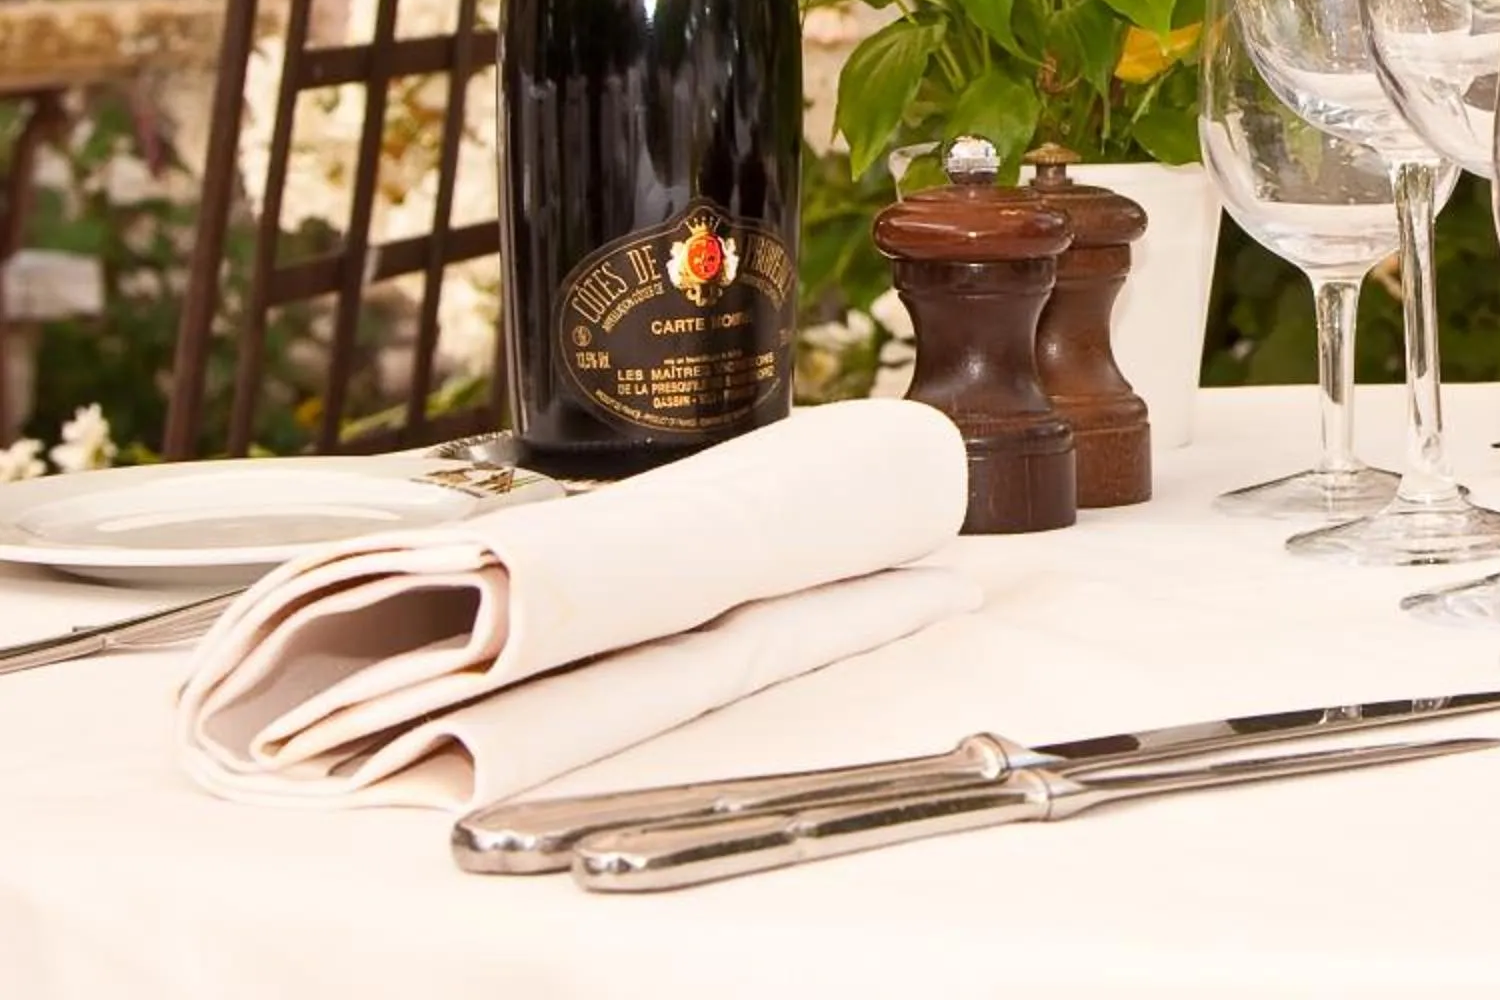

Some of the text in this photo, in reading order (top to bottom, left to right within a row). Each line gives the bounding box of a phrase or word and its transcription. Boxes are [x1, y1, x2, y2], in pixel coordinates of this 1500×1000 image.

[626, 245, 662, 284] DE
[651, 317, 705, 335] CARTE
[617, 369, 644, 381] LES
[617, 383, 632, 395] DE
[635, 383, 649, 395] LA
